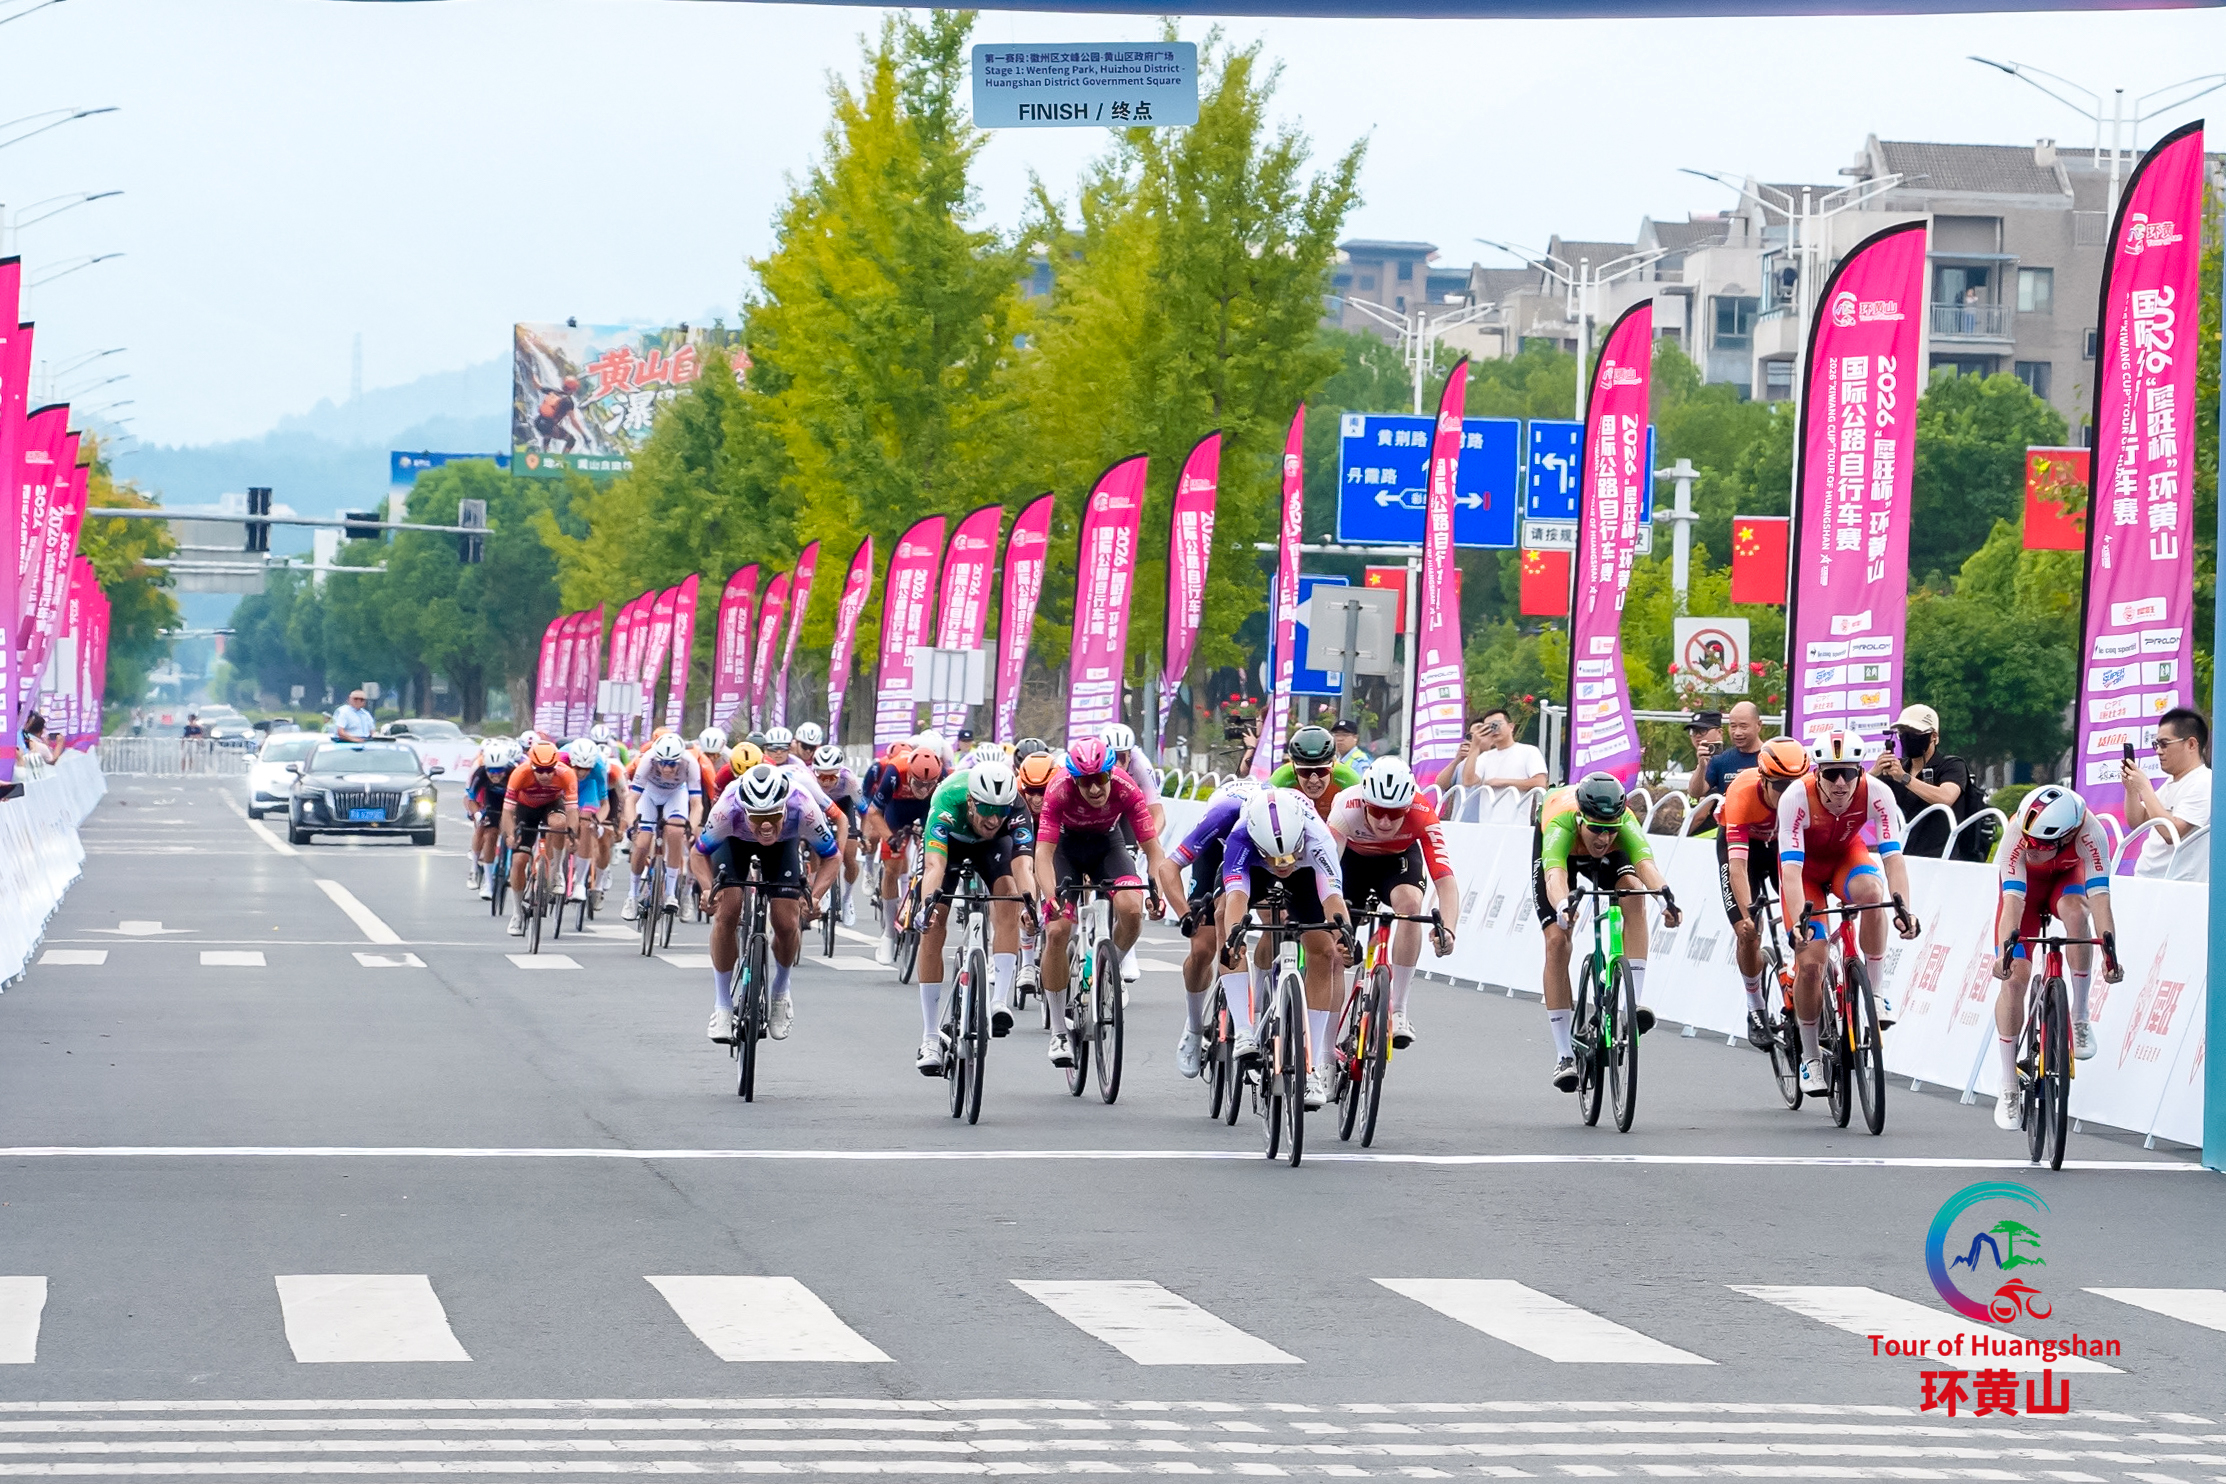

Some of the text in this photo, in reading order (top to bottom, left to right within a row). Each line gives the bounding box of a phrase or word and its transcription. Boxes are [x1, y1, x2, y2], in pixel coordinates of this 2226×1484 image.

[985, 66, 1014, 76] Stage
[1016, 66, 1024, 75] 1:
[1026, 65, 1070, 76] Wenfeng
[1073, 65, 1098, 76] Park,
[1100, 65, 1141, 74] Huizhou
[1144, 64, 1179, 74] District
[985, 76, 1182, 89] Huangshan District Government Square
[1019, 101, 1153, 121] FINISH / 终点
[1836, 356, 1868, 551] 国际公路自行车赛
[1821, 490, 1833, 550] HUANGSHAN
[1792, 807, 1806, 849] LI-NING
[1873, 799, 1891, 840] LI-NING
[2008, 838, 2028, 876] LI-NING
[2081, 834, 2103, 872] LI-NING
